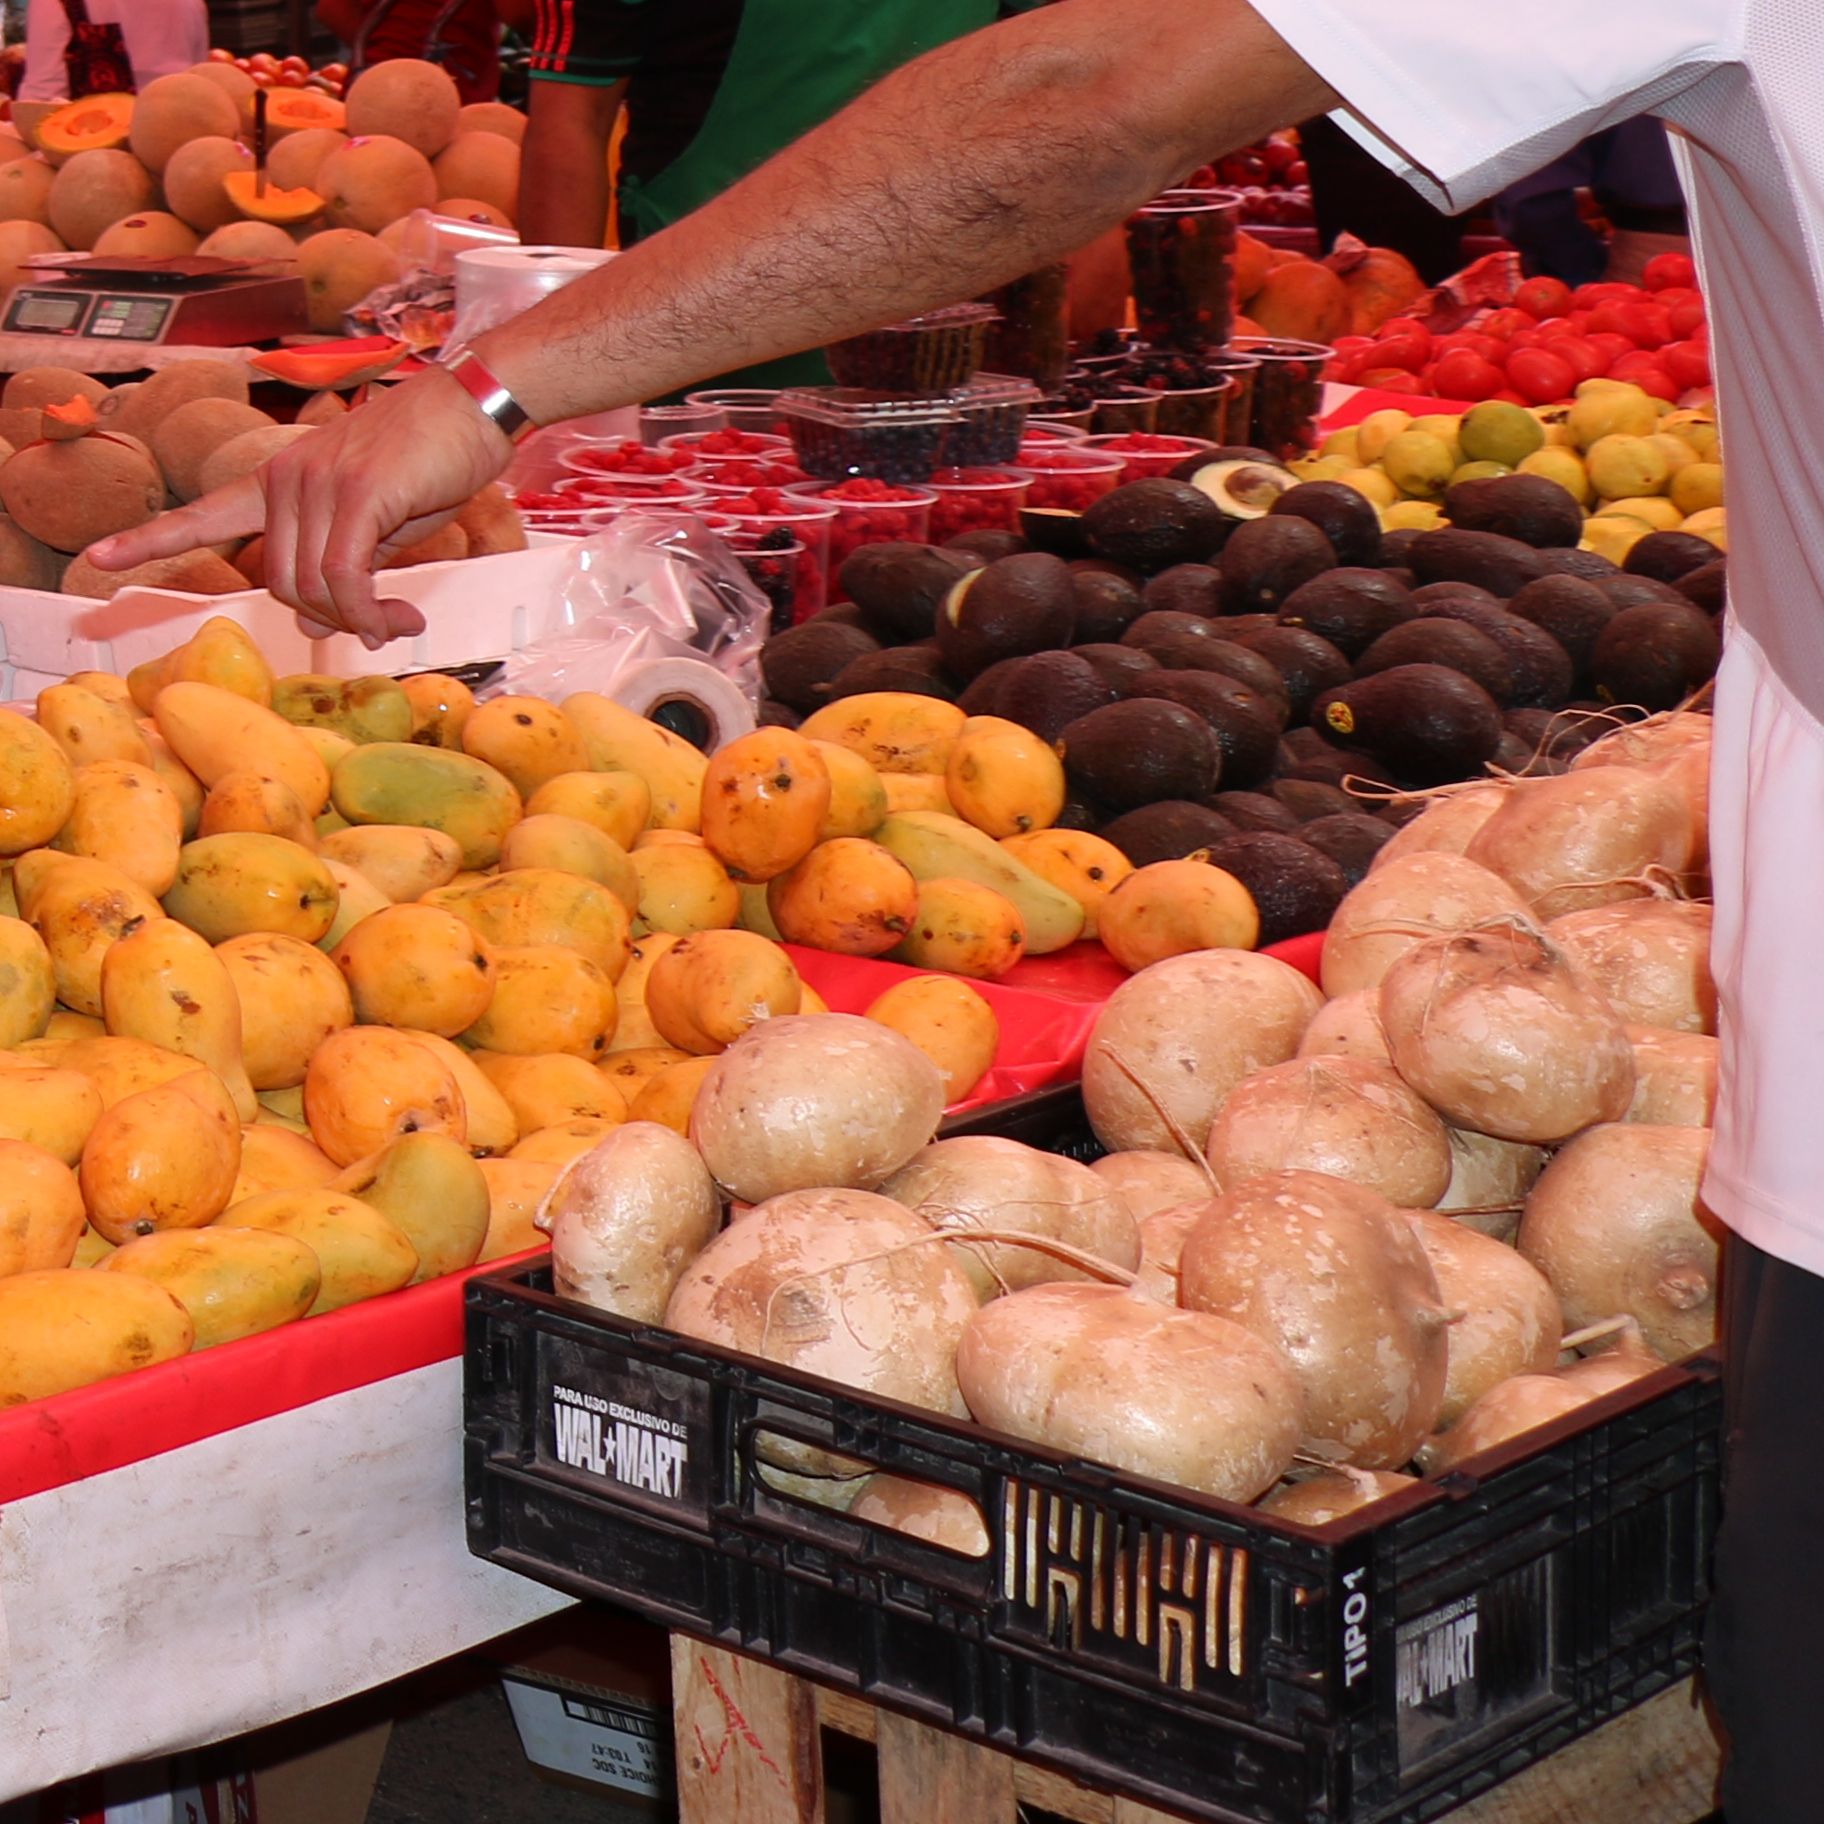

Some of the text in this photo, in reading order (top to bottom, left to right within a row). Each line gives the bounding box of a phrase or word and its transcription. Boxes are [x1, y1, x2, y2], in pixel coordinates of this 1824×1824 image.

[553, 1385, 688, 1440] PARA USO EXCLUSIVO DE
[1342, 1566, 1367, 1687] TIPO 1
